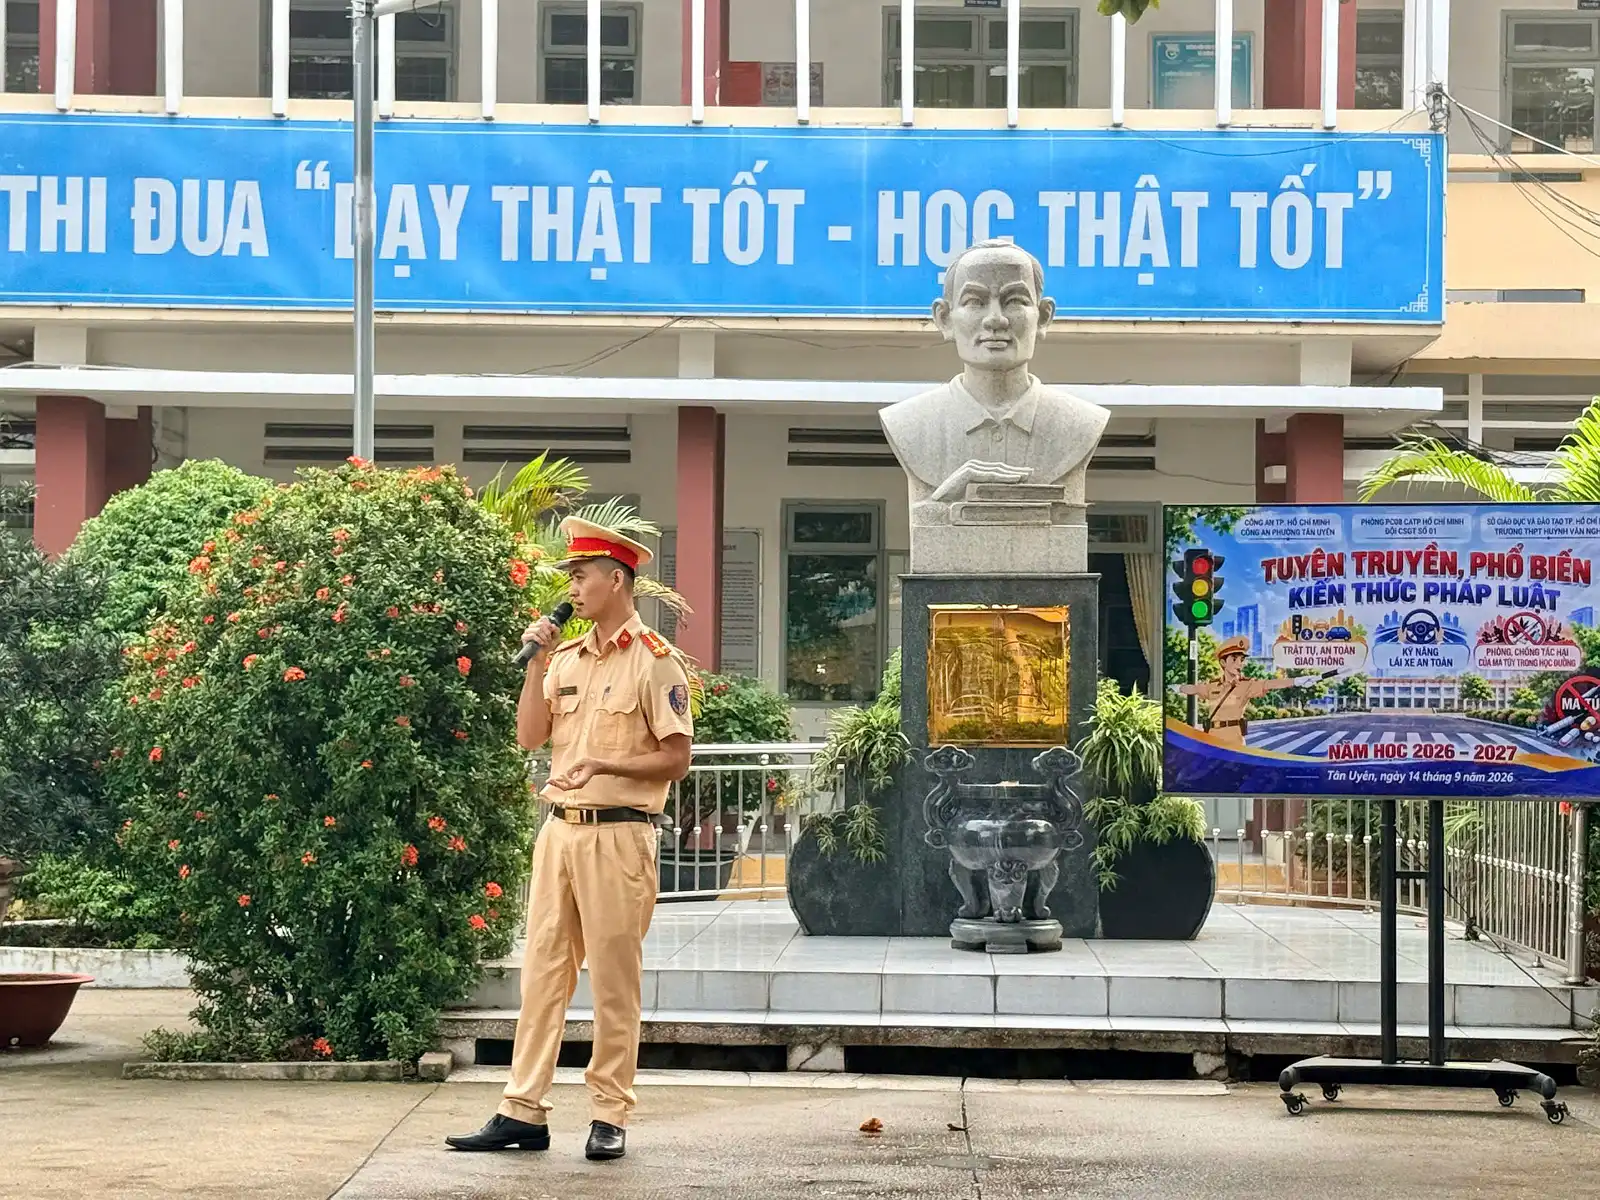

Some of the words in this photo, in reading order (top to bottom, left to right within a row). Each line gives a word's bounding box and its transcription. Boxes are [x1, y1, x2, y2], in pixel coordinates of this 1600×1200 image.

[0, 175, 107, 254] THI
[131, 177, 269, 257] ĐUA
[492, 170, 661, 280] THẬT
[683, 160, 805, 266] TỐT
[828, 226, 852, 241] -
[1039, 174, 1208, 285] THẬT
[1231, 164, 1392, 269] TỐT”
[1244, 518, 1263, 526] CÔNG
[1288, 517, 1298, 526] HỒ
[1300, 518, 1311, 526] CHÍ
[1361, 517, 1385, 526] PHÒNG
[1404, 518, 1422, 526] CATP
[1423, 517, 1433, 525] HỒ
[1434, 517, 1446, 525] CHÍ
[1240, 528, 1259, 536] CÔNG
[1302, 528, 1315, 536] TÂN
[1317, 528, 1335, 536] UYÊN
[1418, 526, 1428, 535] SỐ
[1429, 527, 1437, 535] 01
[1261, 547, 1346, 583] TUYÊN
[1352, 541, 1465, 581] TRUYỀN,
[1470, 542, 1524, 579] PHỔ
[1529, 548, 1591, 587] BIẾN
[1288, 577, 1345, 610] KIẾN
[1352, 577, 1416, 604] THỨC
[1423, 579, 1491, 606] PHÁP
[1497, 582, 1561, 613] LUẬT
[1283, 644, 1305, 655] TRẬT
[1321, 646, 1332, 655] AN
[1333, 645, 1355, 655] TOÀN
[1402, 646, 1414, 656] KỸ
[1416, 646, 1439, 656] NĂNG
[1542, 646, 1555, 656] TÁC
[1294, 657, 1315, 666] GIAO
[1316, 656, 1344, 666] THÔNG
[1389, 657, 1402, 667] LÁI
[1404, 658, 1415, 667] XE
[1417, 658, 1428, 667] AN
[1429, 657, 1453, 667] TOÀN
[1492, 659, 1502, 667] MA
[1517, 659, 1538, 667] TRONG
[1561, 697, 1581, 710] MA
[1328, 741, 1368, 760] NĂM
[1373, 743, 1408, 762] HỌC
[1412, 744, 1455, 759] 2026
[1473, 744, 1518, 761] 2027
[1327, 770, 1346, 781] Tân
[1349, 770, 1377, 782] Uyên,
[1381, 771, 1406, 784] ngày
[1409, 771, 1420, 782] 14
[1422, 771, 1451, 785] tháng
[1454, 772, 1462, 782] 9
[1463, 772, 1485, 782] năm
[1487, 772, 1514, 783] 2026
